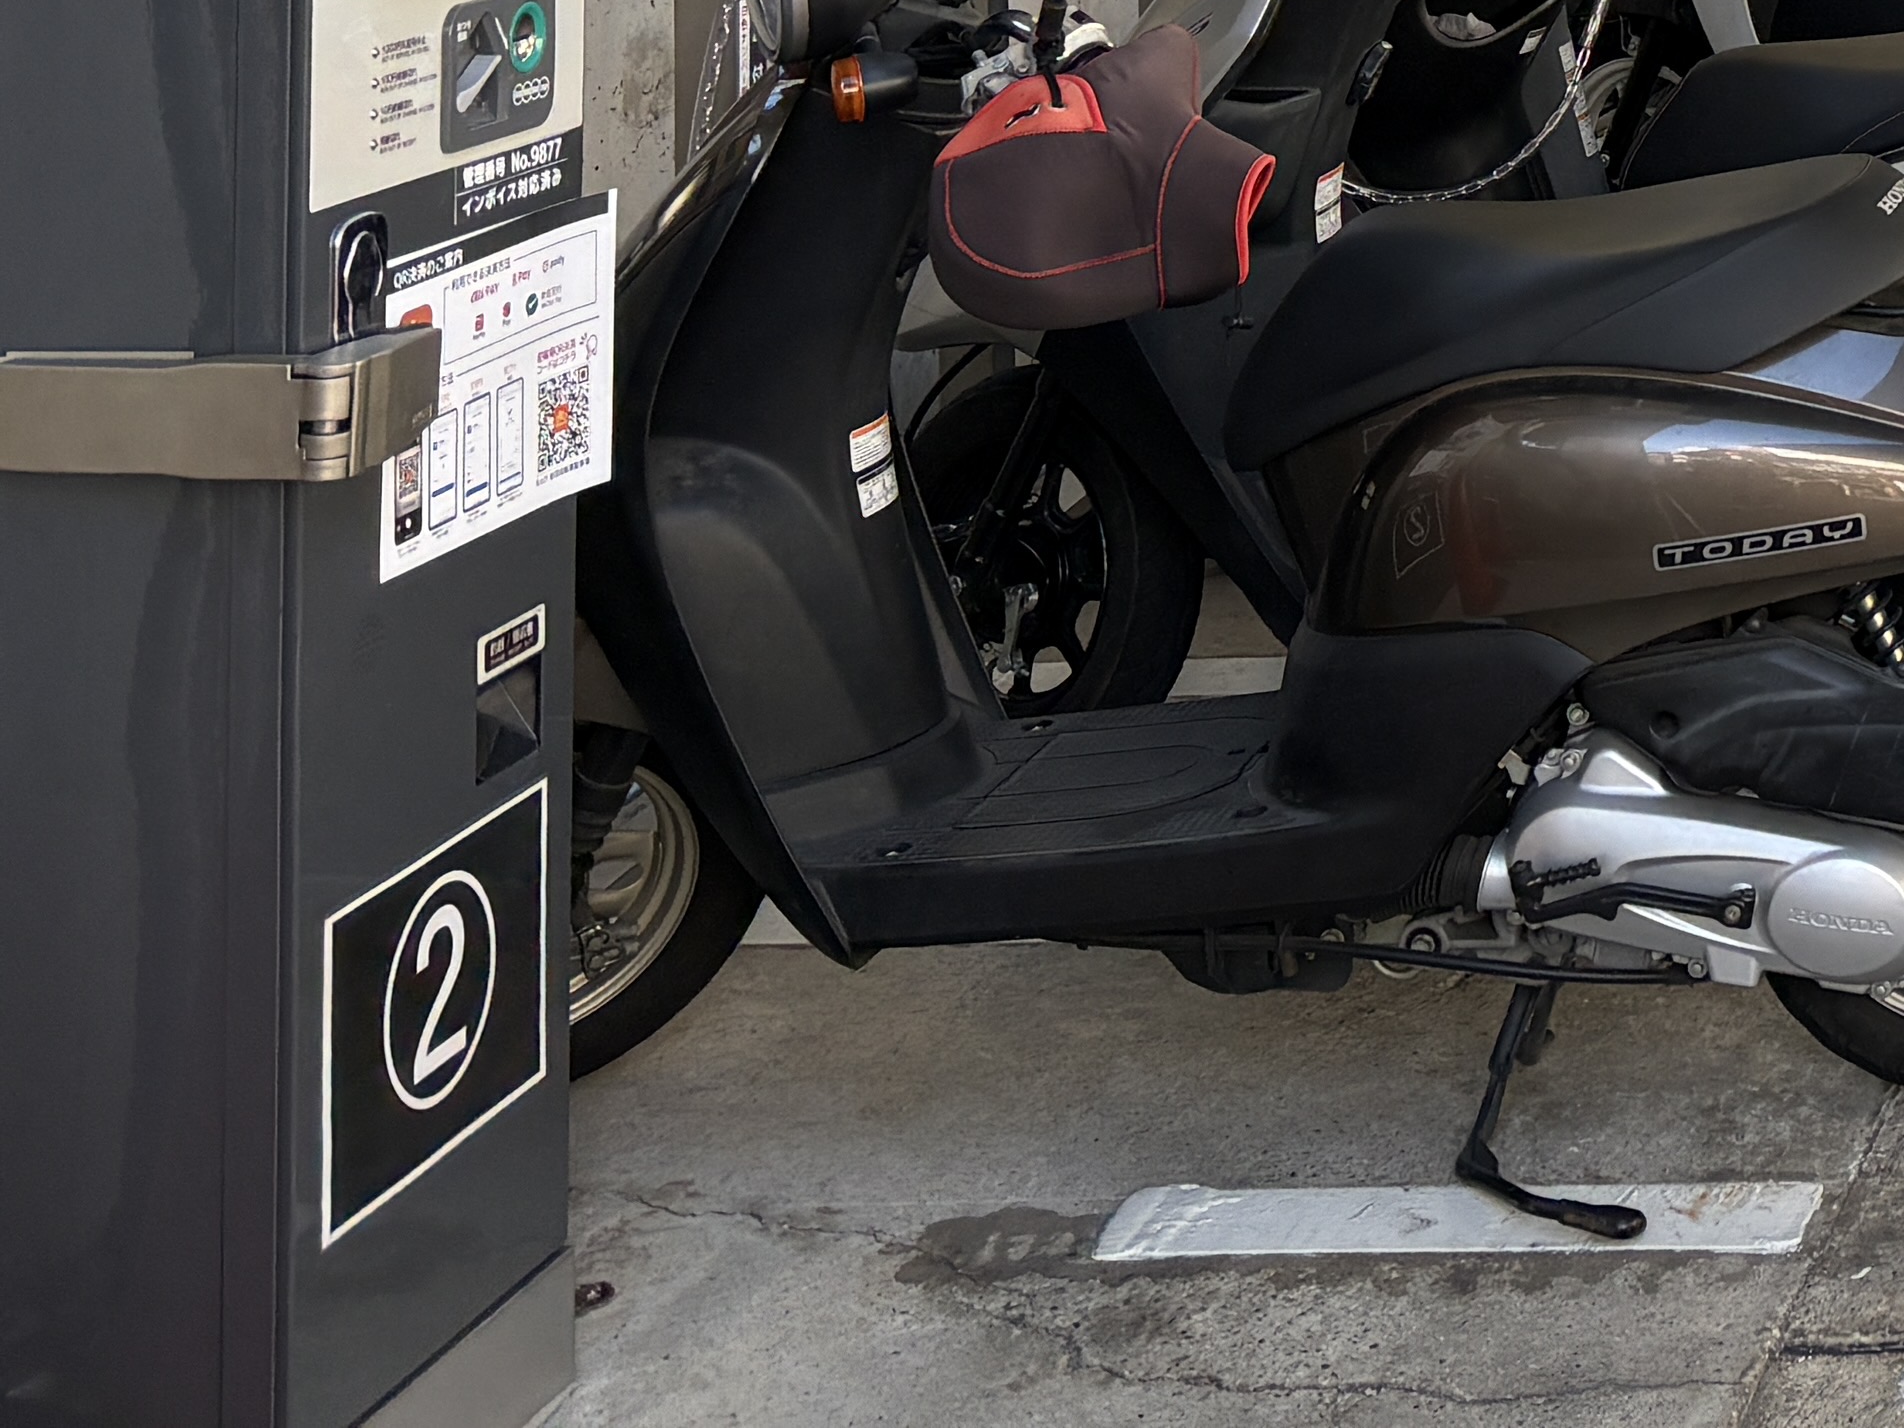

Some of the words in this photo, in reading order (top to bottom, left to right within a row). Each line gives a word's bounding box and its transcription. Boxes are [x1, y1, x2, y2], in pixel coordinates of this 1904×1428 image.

[463, 157, 506, 187] 管理番号
[511, 137, 562, 174] No.9877
[461, 168, 562, 217] インボイス対応済み
[393, 248, 464, 289] QR決済のご案内
[1663, 521, 1854, 565] TODAY
[1788, 907, 1895, 936] HONDA
